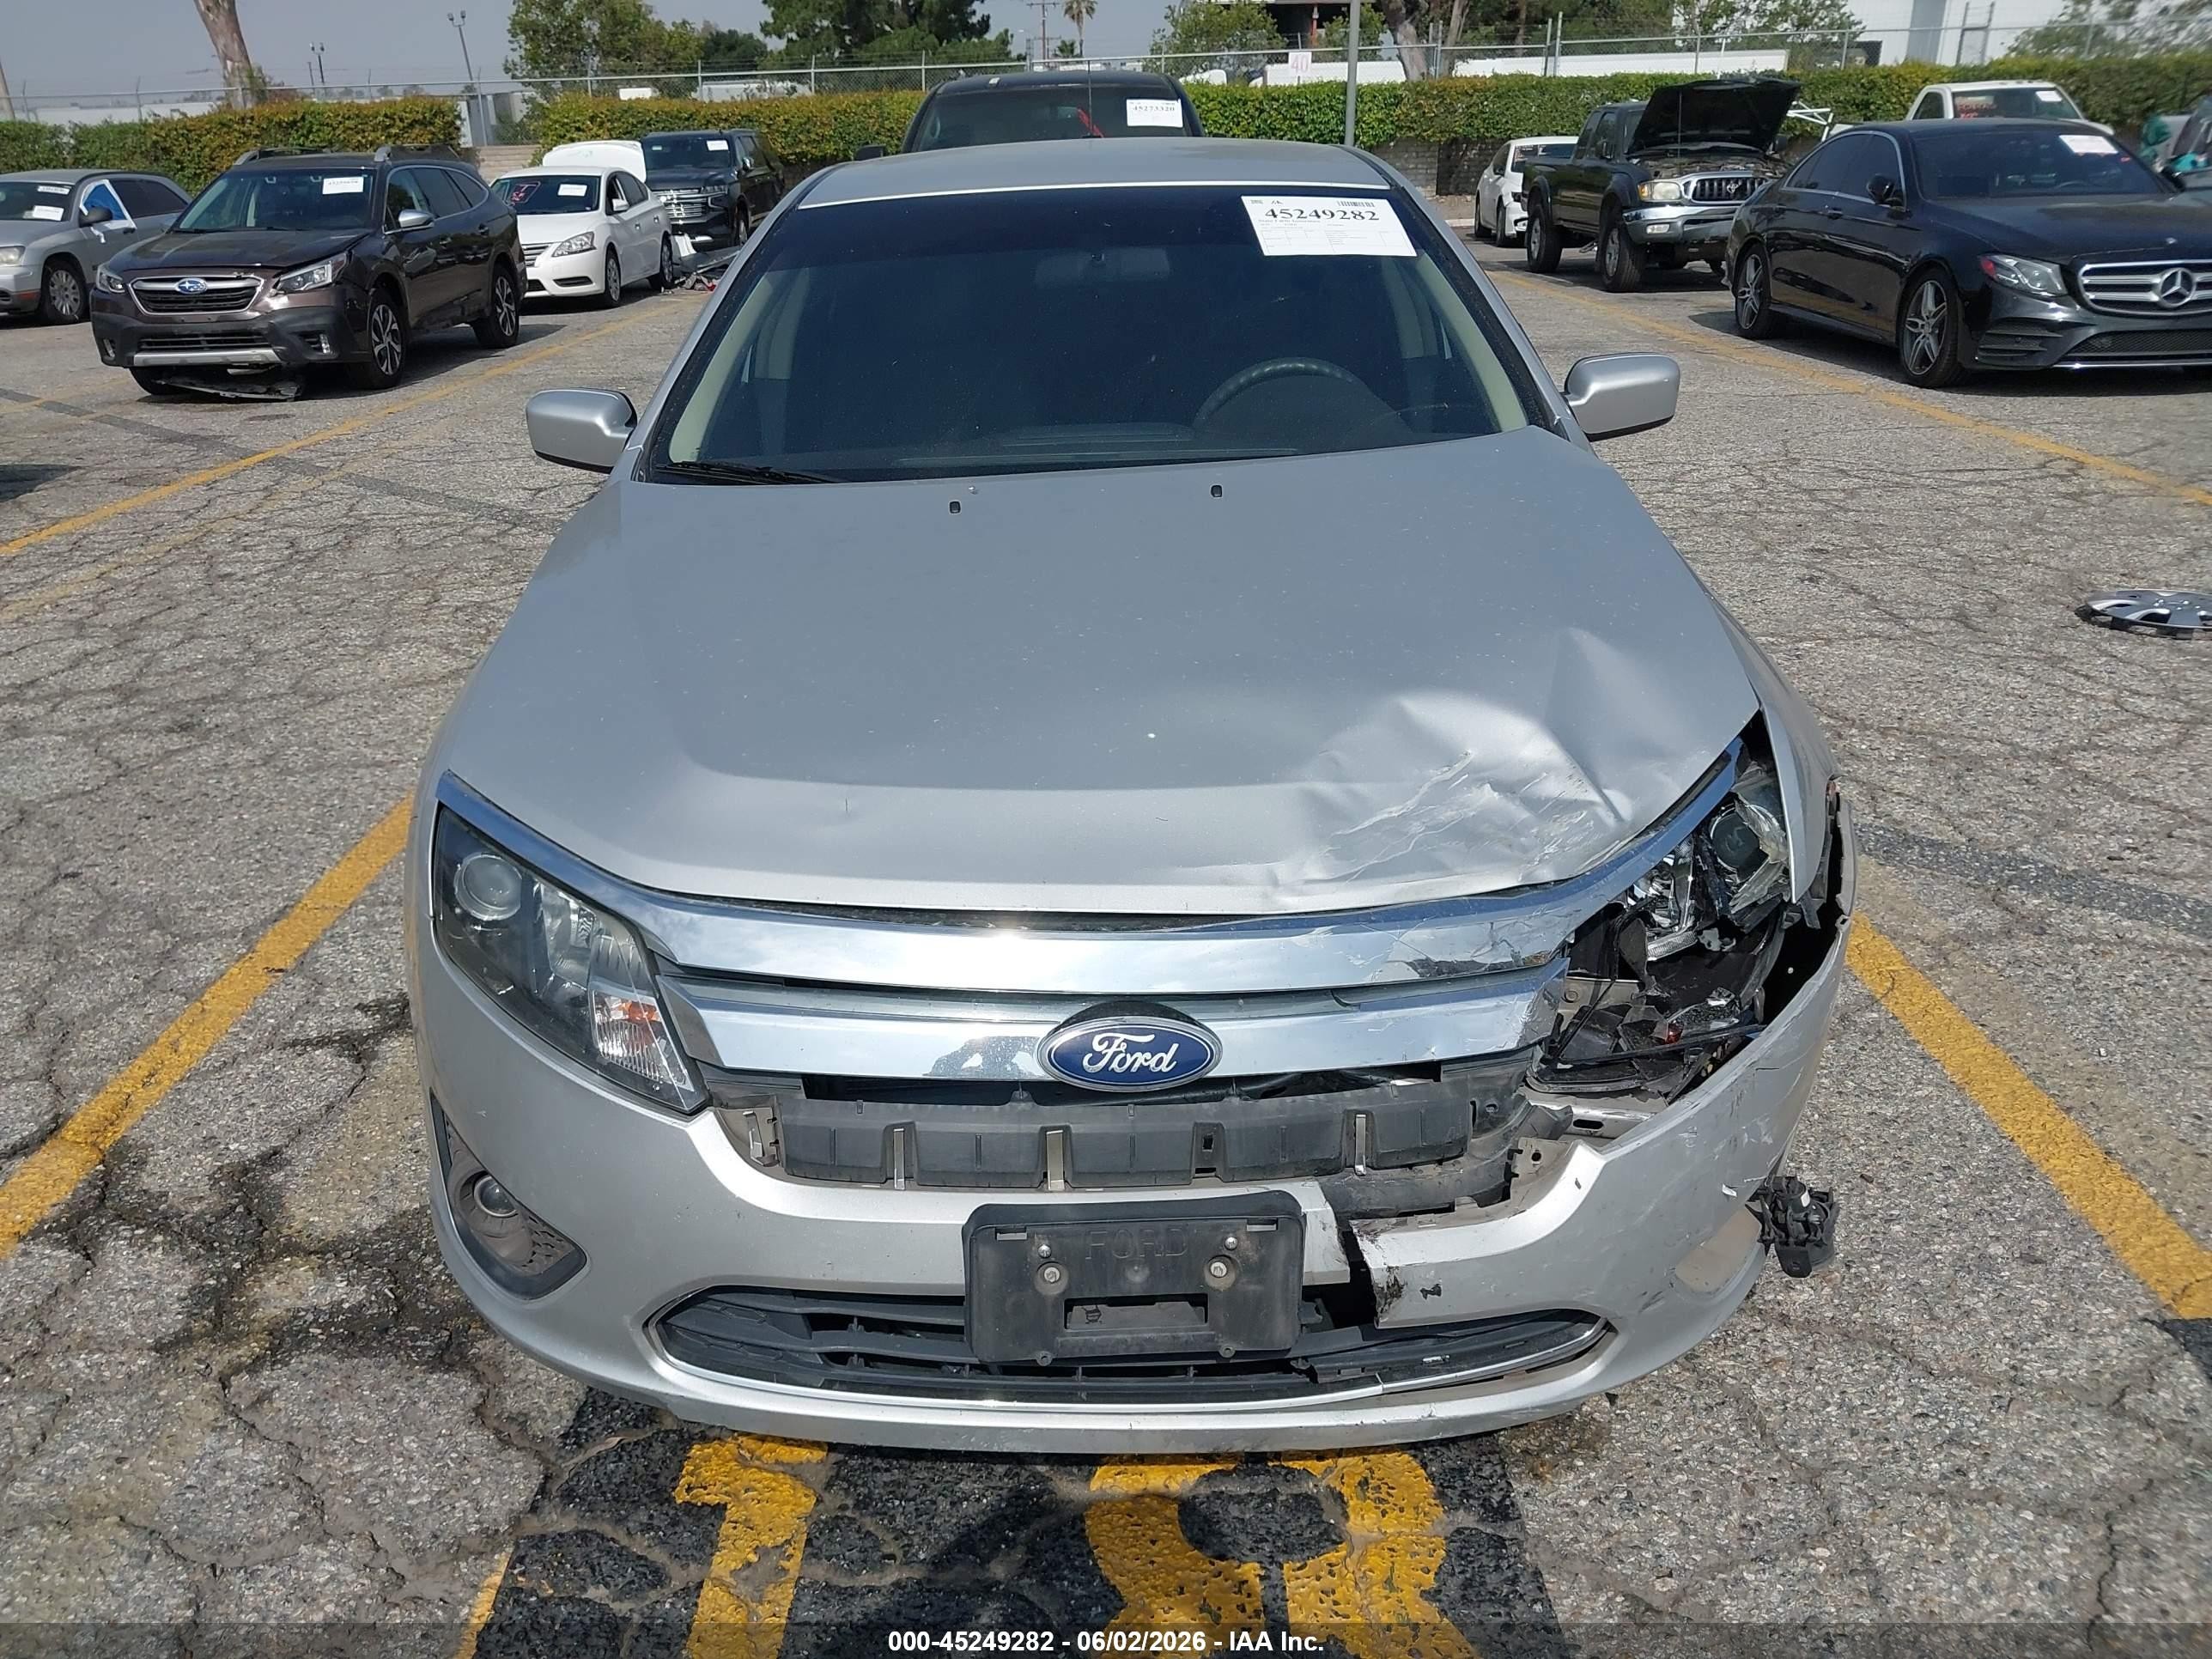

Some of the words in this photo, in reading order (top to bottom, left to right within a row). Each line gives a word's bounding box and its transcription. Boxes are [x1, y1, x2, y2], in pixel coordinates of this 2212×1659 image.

[1291, 54, 1309, 74] 40
[1265, 208, 1380, 222] 45249282
[1082, 1032, 1180, 1073] Ford
[1085, 1227, 1188, 1261] FORD
